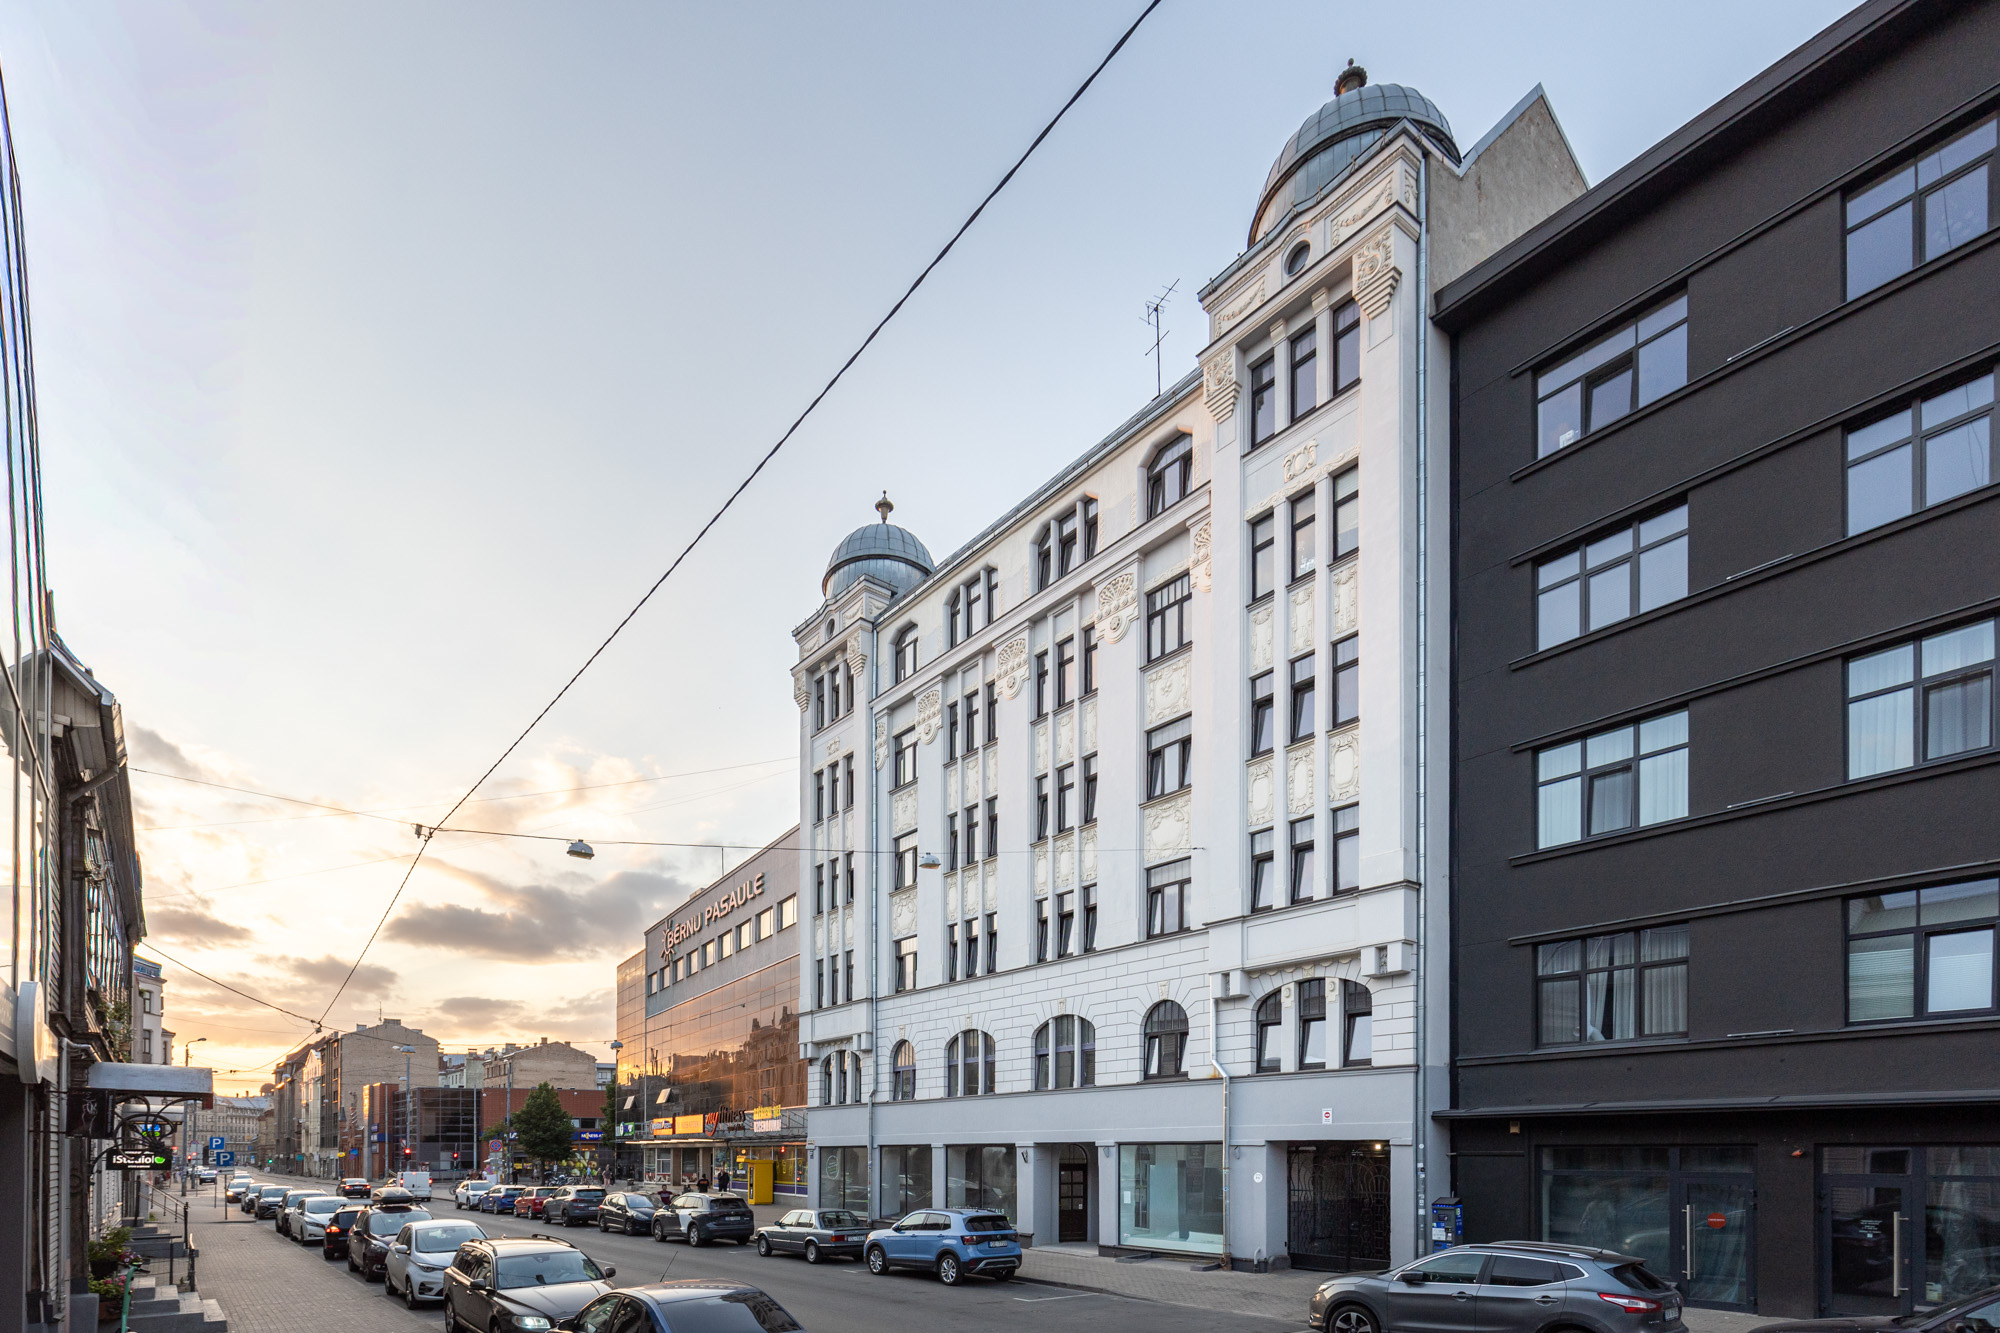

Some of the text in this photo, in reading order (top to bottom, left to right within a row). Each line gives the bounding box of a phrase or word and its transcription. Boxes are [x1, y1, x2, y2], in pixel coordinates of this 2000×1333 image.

[667, 872, 765, 948] BĒRNU PASAULE
[705, 1111, 719, 1137] my
[719, 1104, 746, 1123] fitness
[212, 1138, 221, 1149] P
[220, 1153, 231, 1165] P
